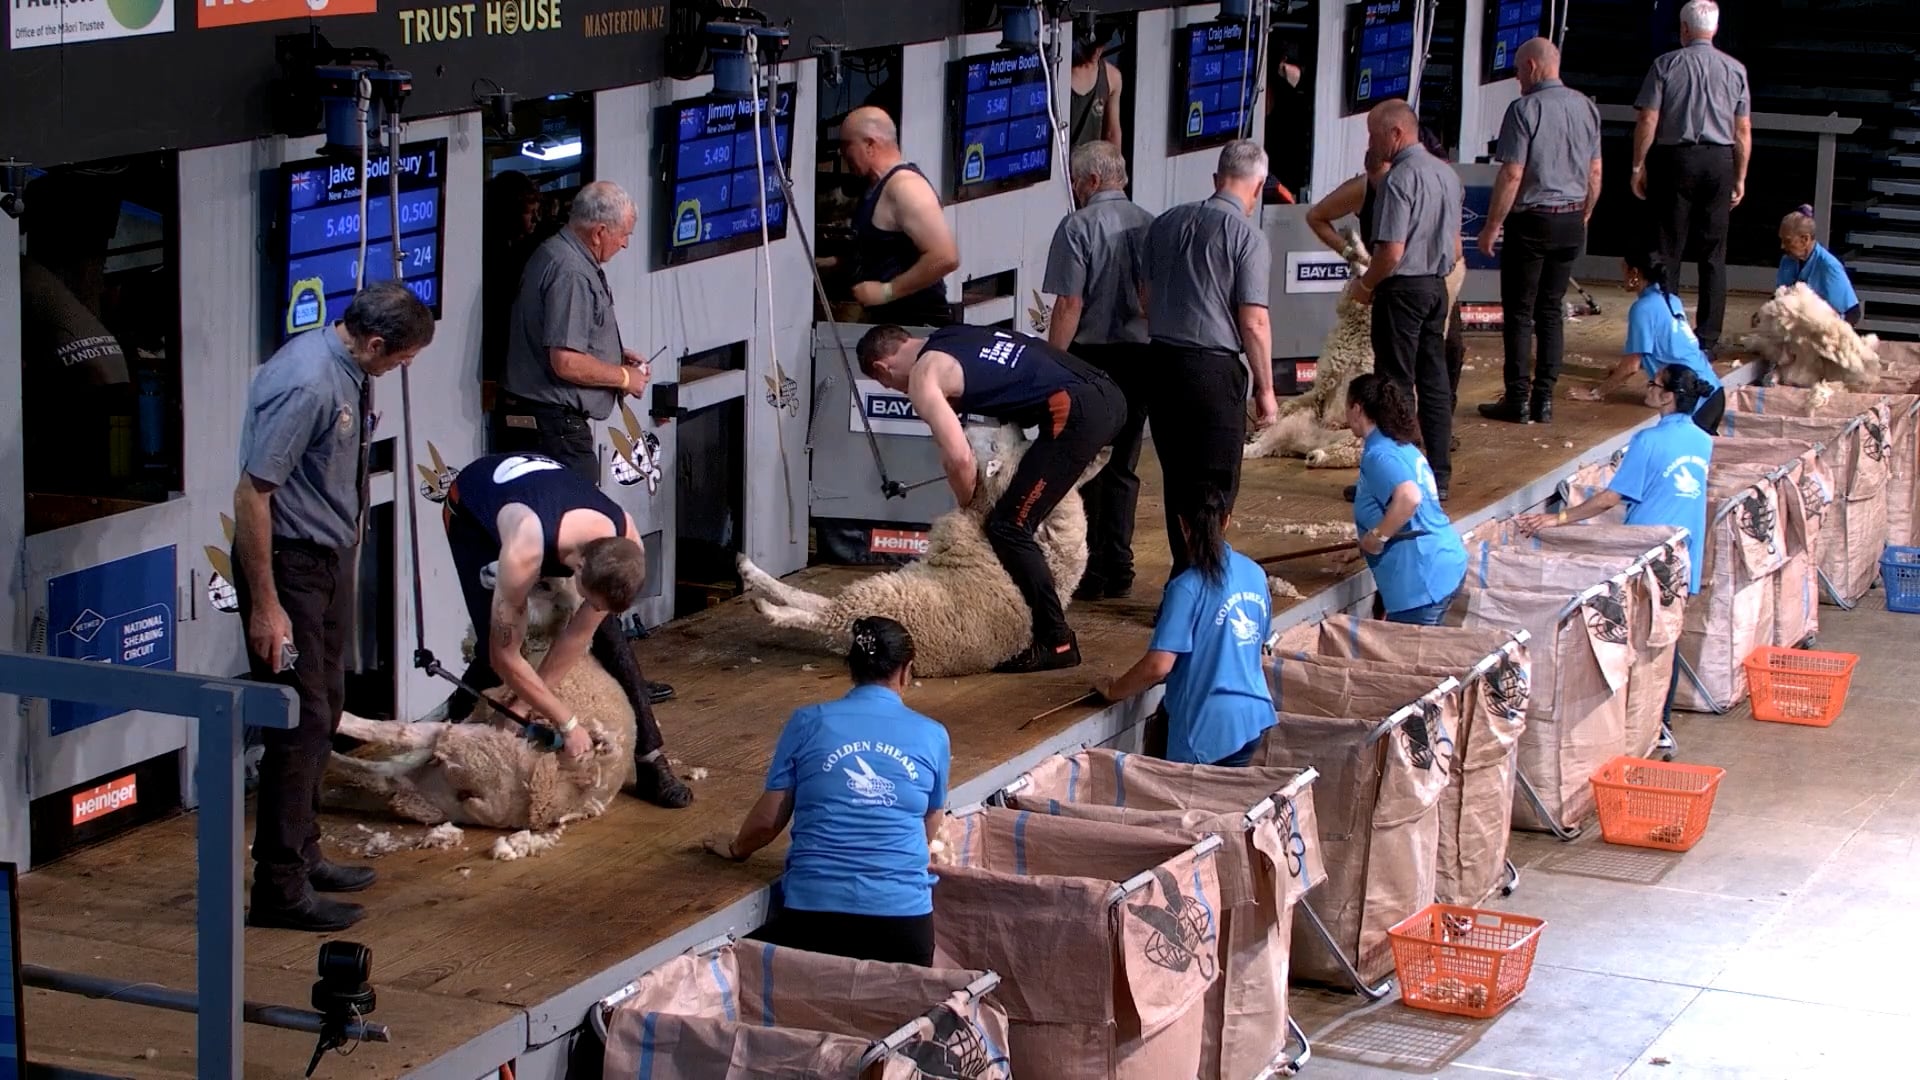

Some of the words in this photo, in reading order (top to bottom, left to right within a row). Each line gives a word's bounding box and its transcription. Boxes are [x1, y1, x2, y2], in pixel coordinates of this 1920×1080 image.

[15, 27, 35, 39] Office
[36, 25, 44, 36] of
[45, 24, 57, 35] the
[79, 20, 105, 31] Trustee
[399, 4, 476, 45] TRUST
[584, 5, 666, 38] MASTERTON.NZ
[990, 58, 1018, 75] Andrew
[1018, 53, 1040, 69] Booth
[706, 102, 737, 124] Jimmy
[738, 97, 769, 117] Naper
[703, 145, 730, 166] 5.490
[328, 162, 356, 189] Jake
[428, 150, 438, 178] 1
[328, 189, 342, 201] New
[325, 213, 361, 238] 5.490
[401, 200, 433, 223] 0.500
[749, 203, 780, 228] 5.90
[413, 244, 432, 267] 2/4
[1300, 266, 1352, 278] BAYLEY
[62, 347, 101, 367] LANDS
[979, 347, 992, 359] TE
[873, 530, 929, 554] Heinig
[123, 614, 164, 635] NATIONAL
[123, 627, 164, 649] SHEARING
[123, 642, 156, 661] CIRCUIT
[822, 740, 871, 773] GOLDEN
[874, 742, 919, 781] SHEARS
[75, 782, 136, 818] Heiniger
